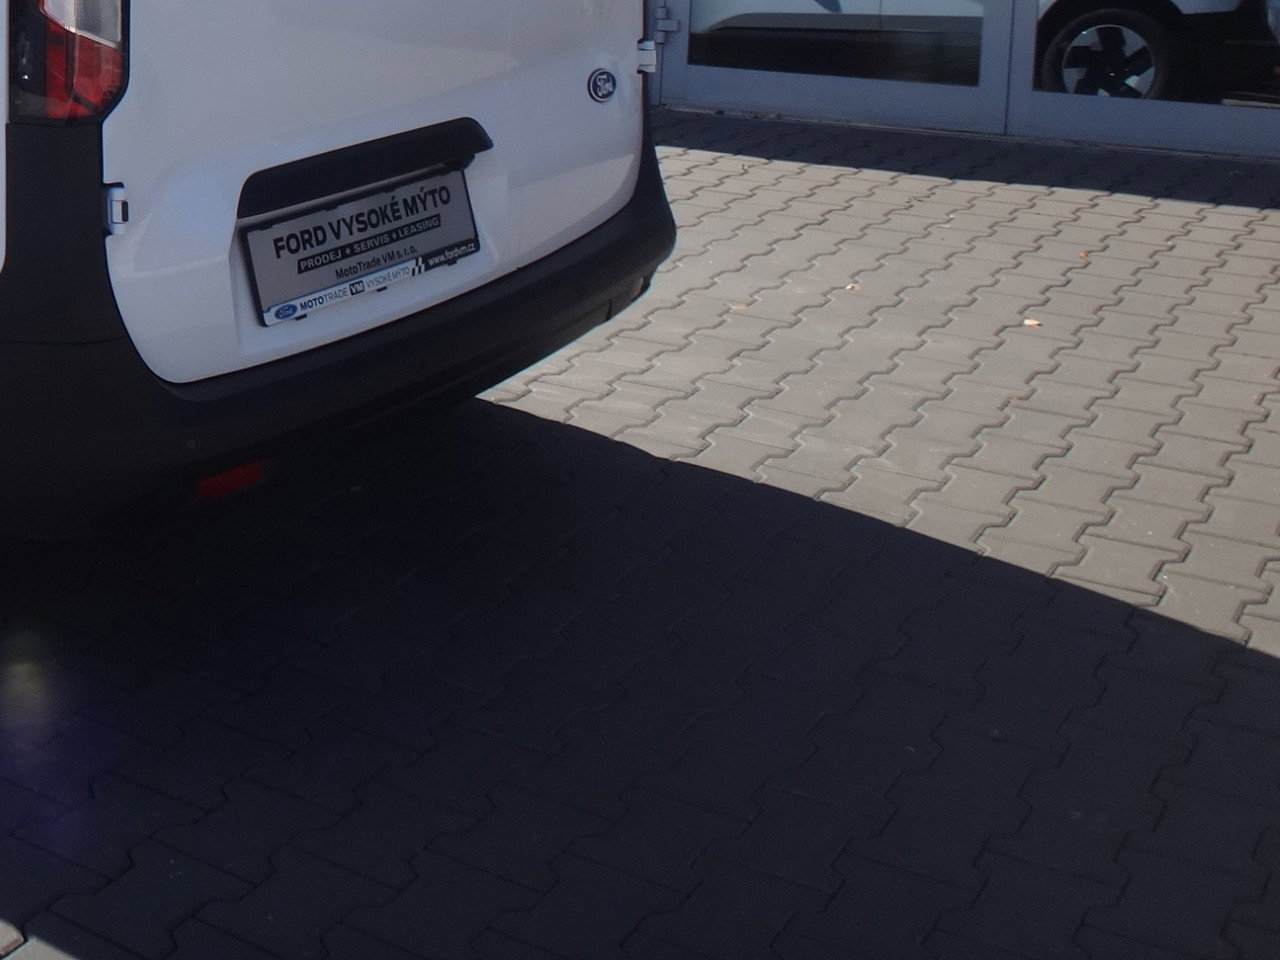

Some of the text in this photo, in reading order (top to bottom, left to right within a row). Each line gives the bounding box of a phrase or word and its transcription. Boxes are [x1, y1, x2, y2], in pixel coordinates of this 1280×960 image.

[273, 186, 451, 259] FORD VYSOKÉ MÝTO
[300, 217, 439, 271] PRODEJ SERVIS LEASING
[427, 242, 477, 267] www.fordvm.cz
[335, 257, 381, 280] MotoTrade
[381, 249, 396, 264] VM
[300, 287, 349, 311] MOTOTRADE
[350, 281, 364, 295] VM
